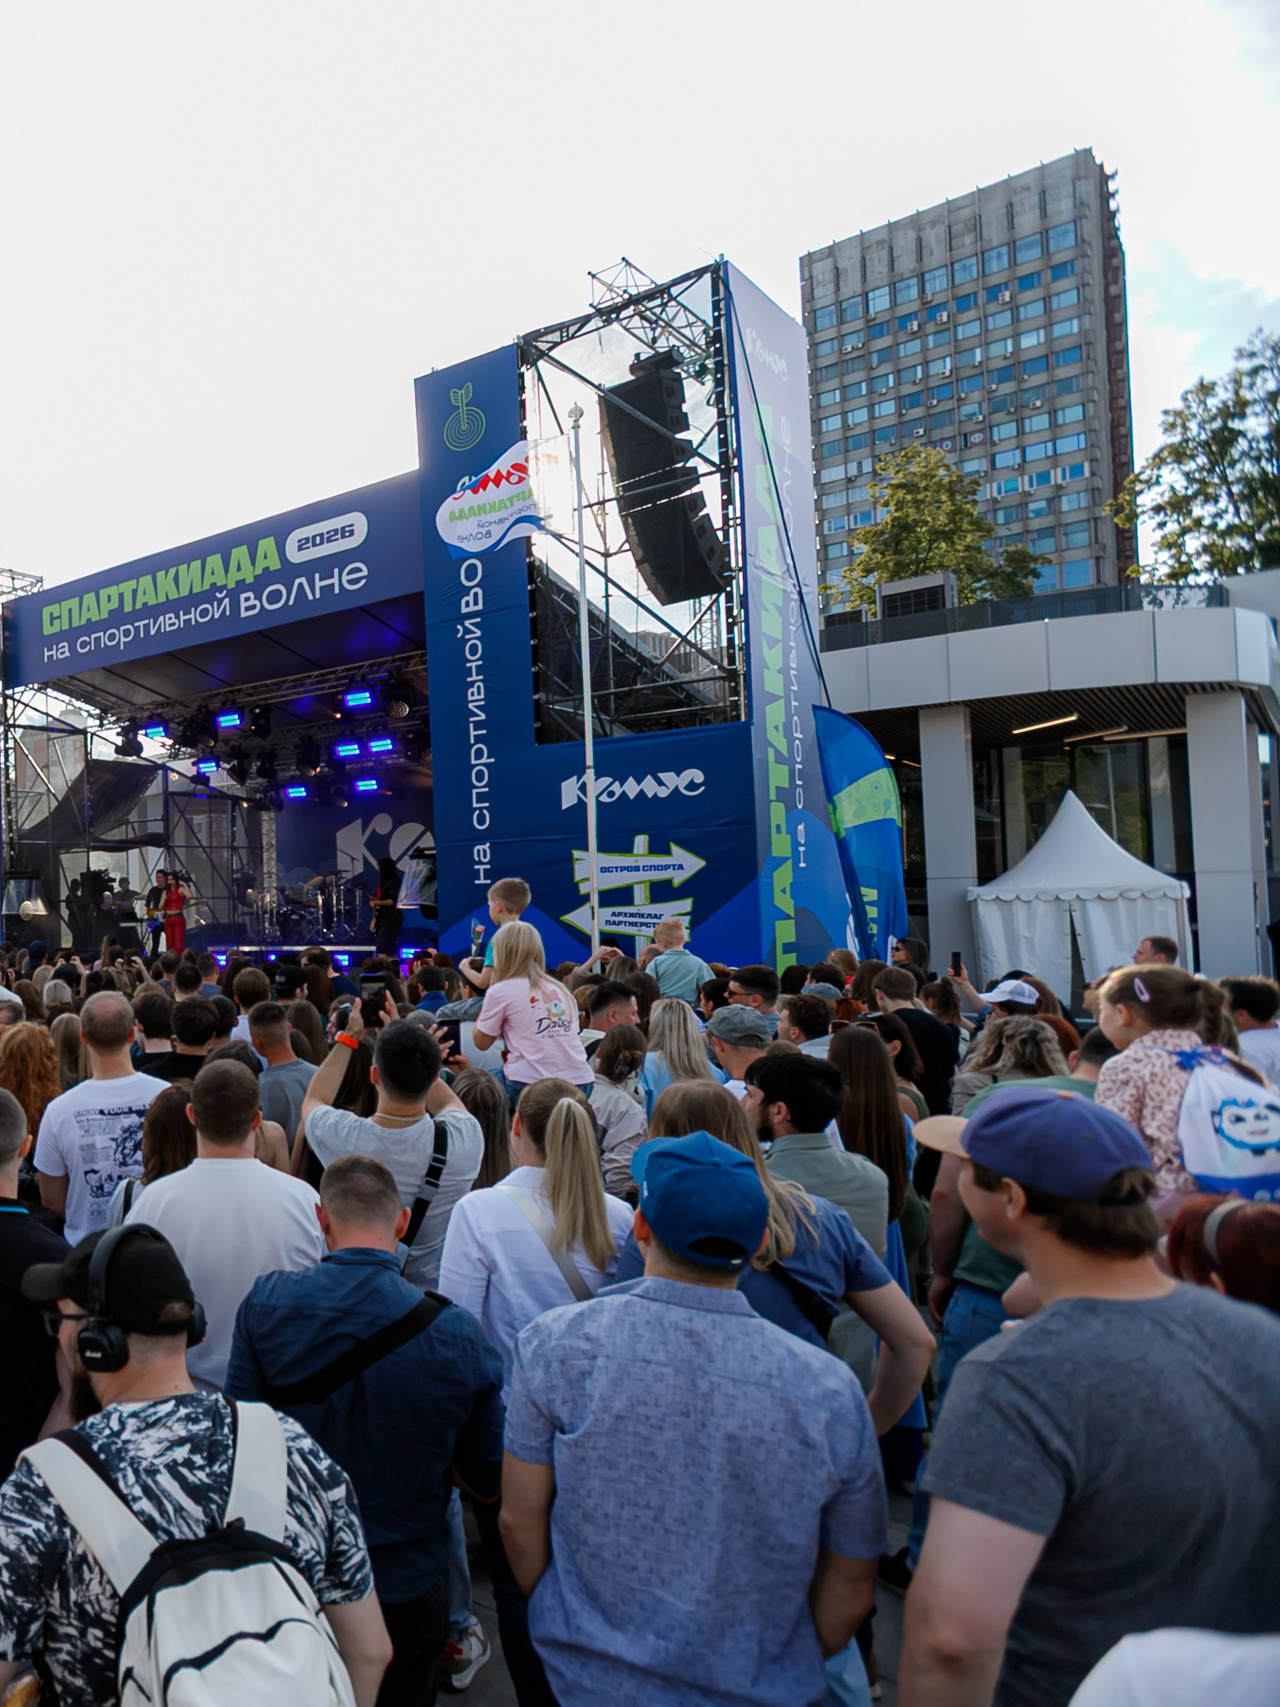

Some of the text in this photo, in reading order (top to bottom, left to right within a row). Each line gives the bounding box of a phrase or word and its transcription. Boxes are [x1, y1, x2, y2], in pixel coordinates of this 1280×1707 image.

[42, 523, 355, 636] СПАРТАКИАДА 2026
[44, 641, 71, 663] на
[76, 590, 230, 654] спортивной
[752, 404, 798, 978] ПАРТАКИАДА
[456, 616, 496, 830] спортивной
[474, 842, 491, 885] на
[796, 822, 807, 867] на
[599, 863, 685, 873] ОСТРОВ СПОРТА
[604, 919, 661, 928] ПАРТНЕРСТ
[610, 911, 665, 920] АРХИПЕЛАГ
